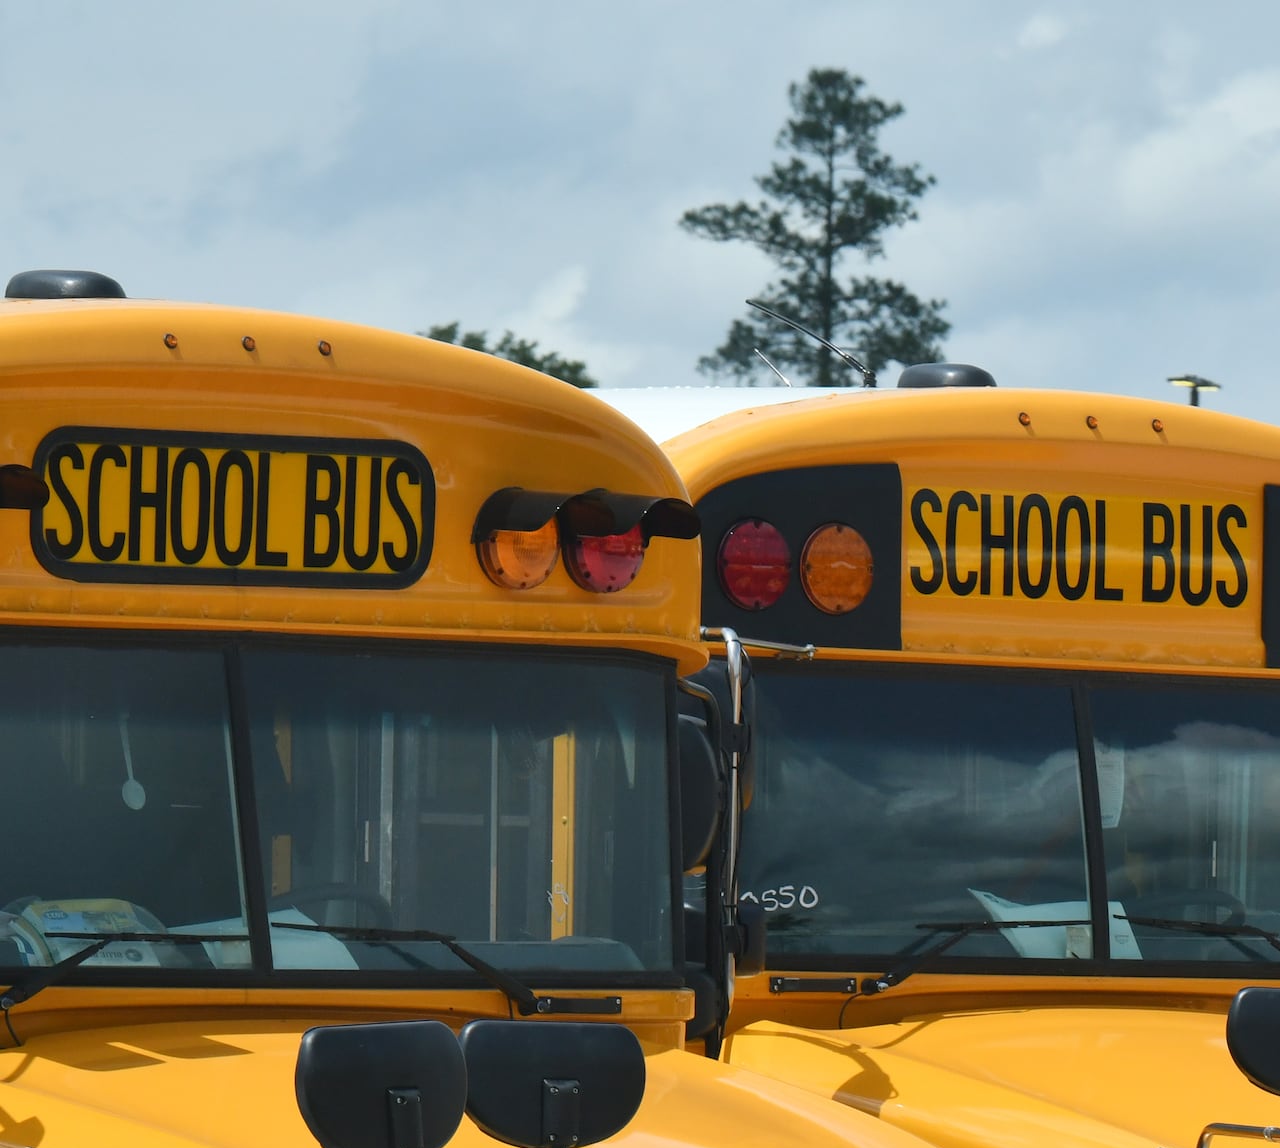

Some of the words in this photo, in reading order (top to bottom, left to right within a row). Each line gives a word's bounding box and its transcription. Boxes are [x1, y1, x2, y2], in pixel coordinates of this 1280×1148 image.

[44, 442, 289, 567] SCHOOL
[303, 452, 421, 573] BUS
[909, 487, 1124, 602] SCHOOL
[1141, 502, 1249, 609] BUS
